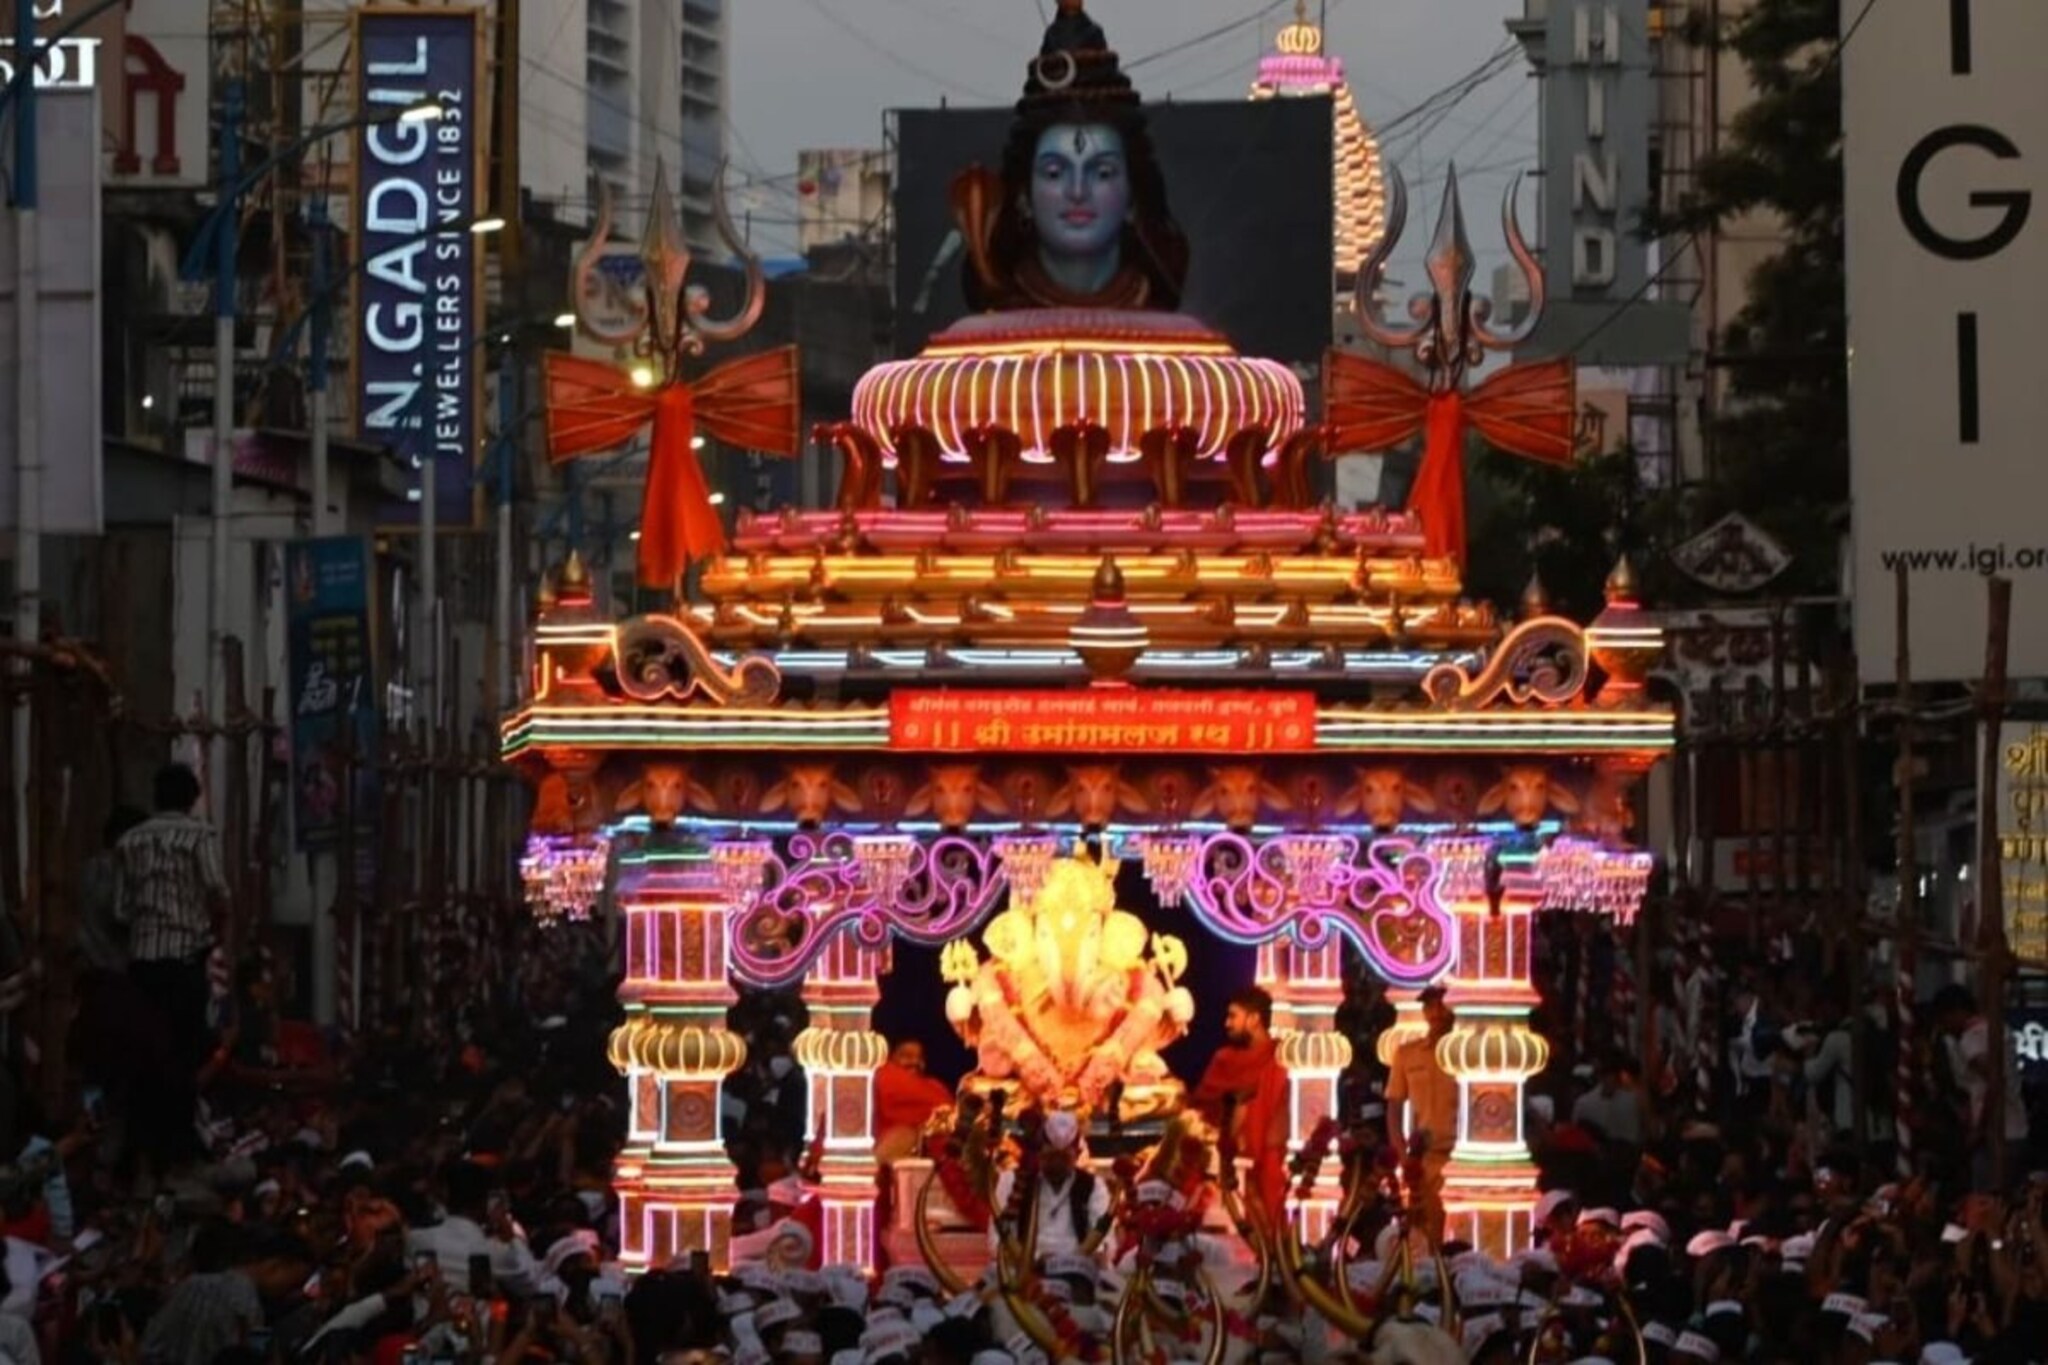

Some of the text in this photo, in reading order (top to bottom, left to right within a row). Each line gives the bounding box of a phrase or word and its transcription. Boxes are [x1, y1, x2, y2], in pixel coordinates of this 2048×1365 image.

[436, 169, 461, 259] SINCE
[436, 275, 462, 454] JEWELLERS
[1881, 542, 2048, 577] www.igi.or
